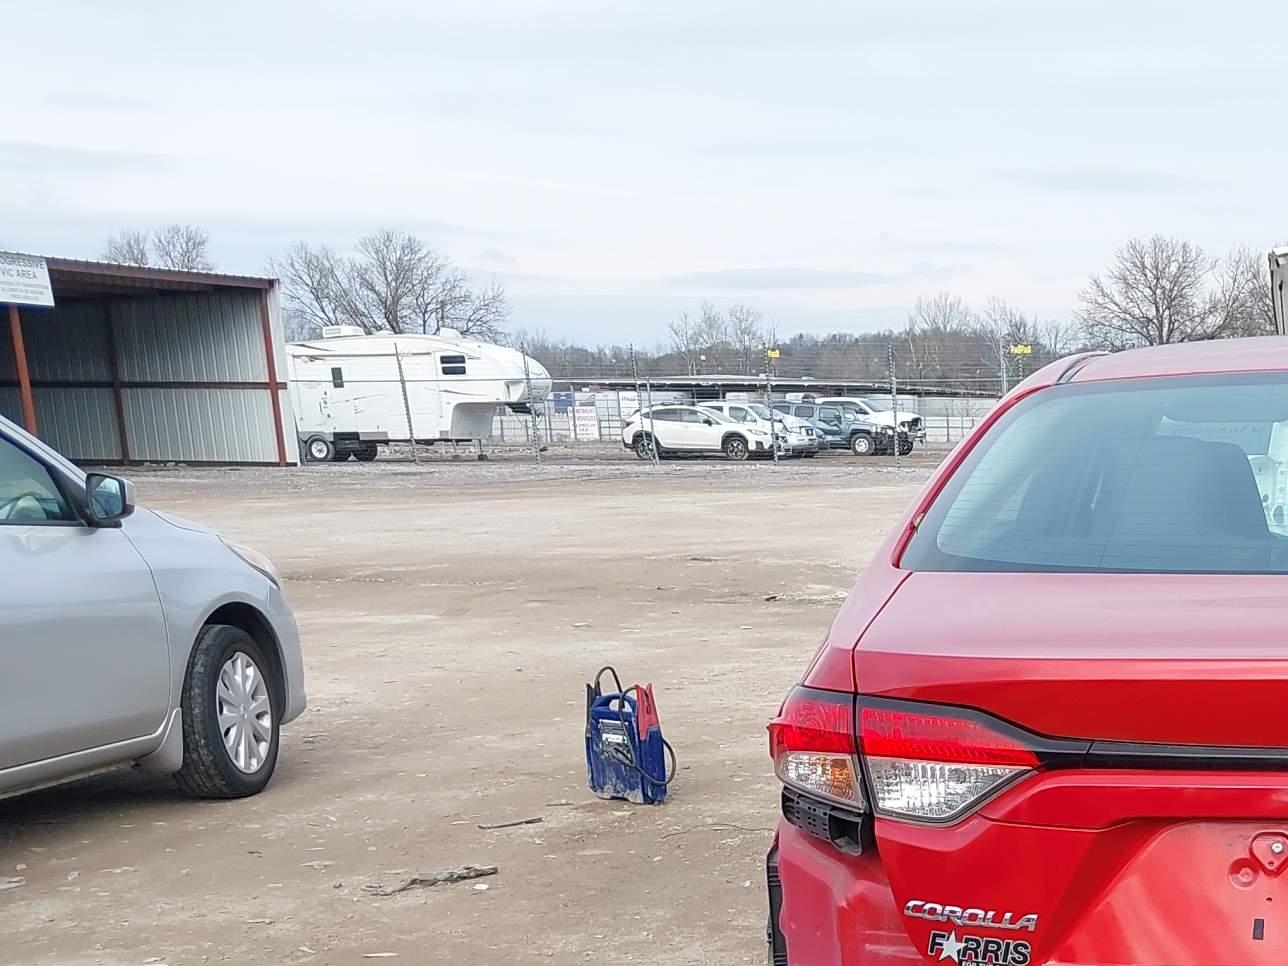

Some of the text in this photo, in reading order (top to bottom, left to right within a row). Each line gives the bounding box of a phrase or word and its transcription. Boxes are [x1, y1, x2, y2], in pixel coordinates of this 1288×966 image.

[16, 269, 39, 280] AREA
[904, 900, 1038, 931] COROLLA
[928, 930, 1030, 966] FRRIS
